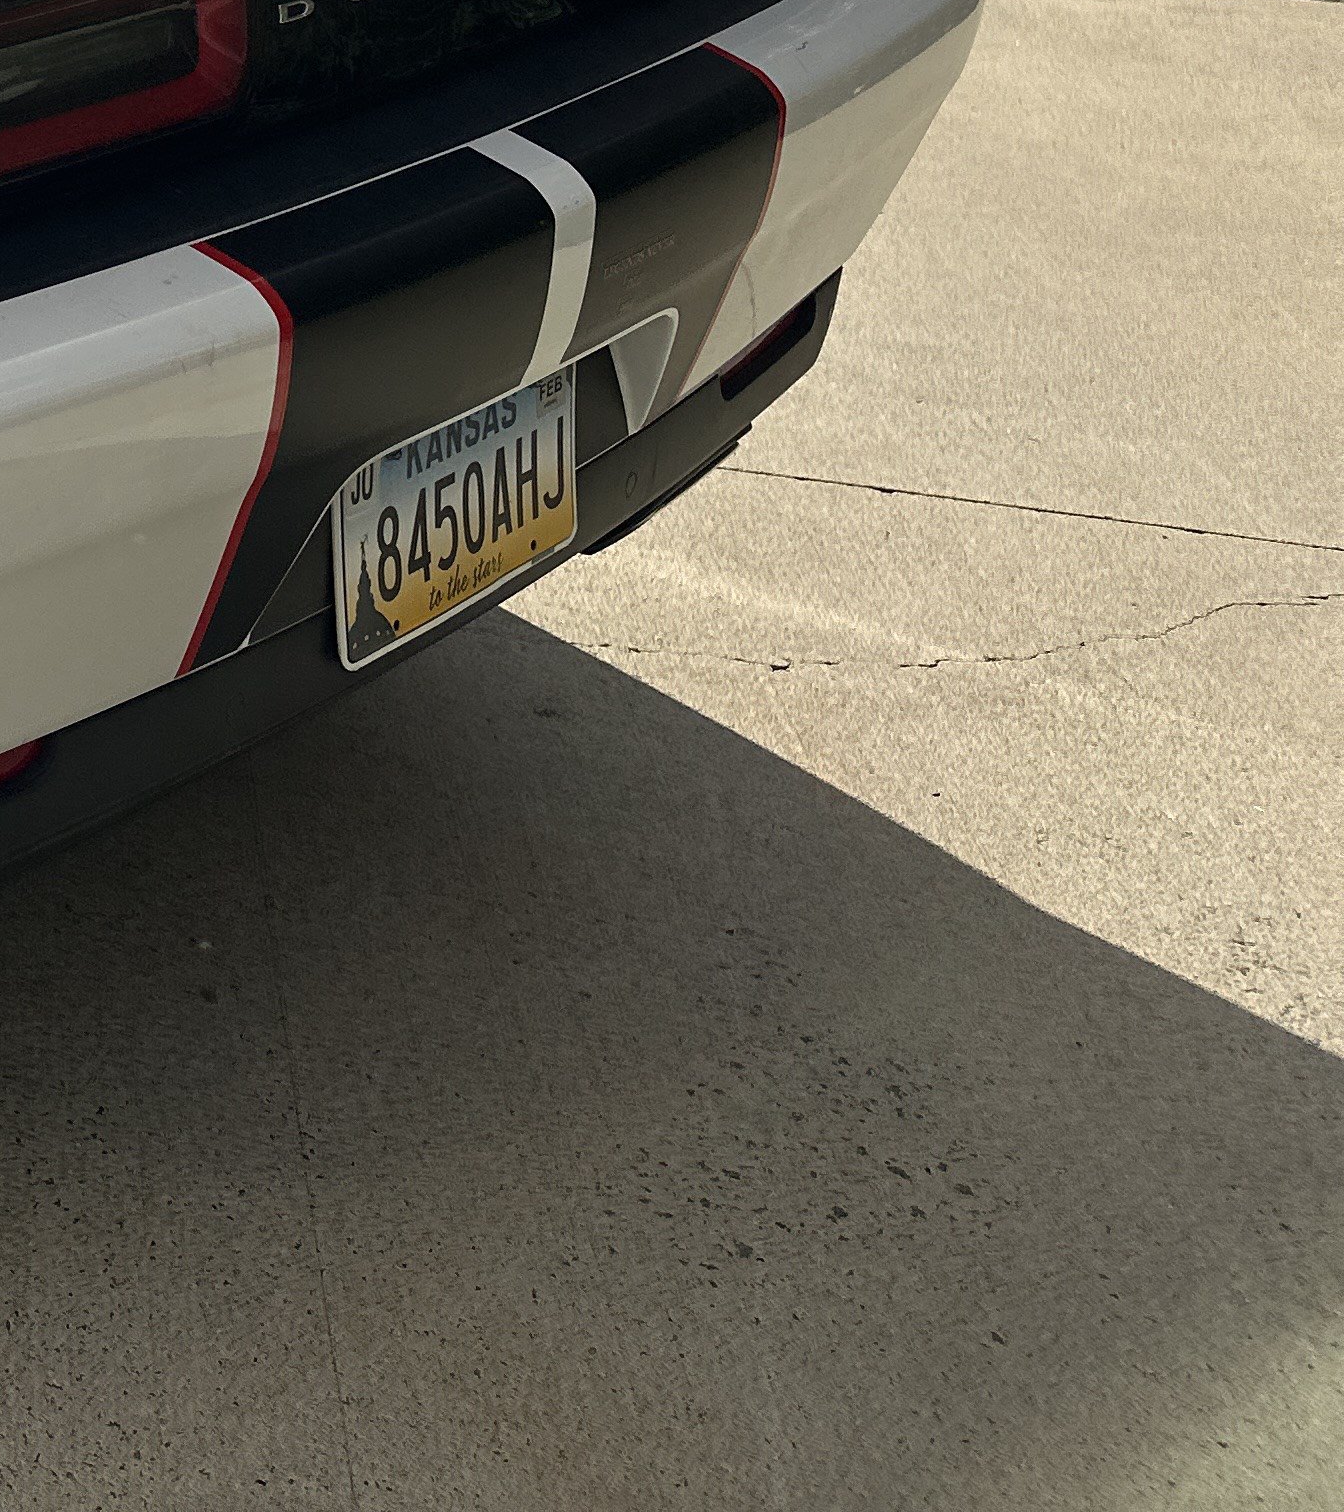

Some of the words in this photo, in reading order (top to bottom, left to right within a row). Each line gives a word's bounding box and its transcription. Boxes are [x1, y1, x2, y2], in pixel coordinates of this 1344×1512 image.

[539, 375, 563, 402] FEB
[406, 392, 517, 480] KANSAS
[376, 415, 566, 603] 8450AHJ
[428, 585, 443, 612] to
[446, 563, 469, 601] the
